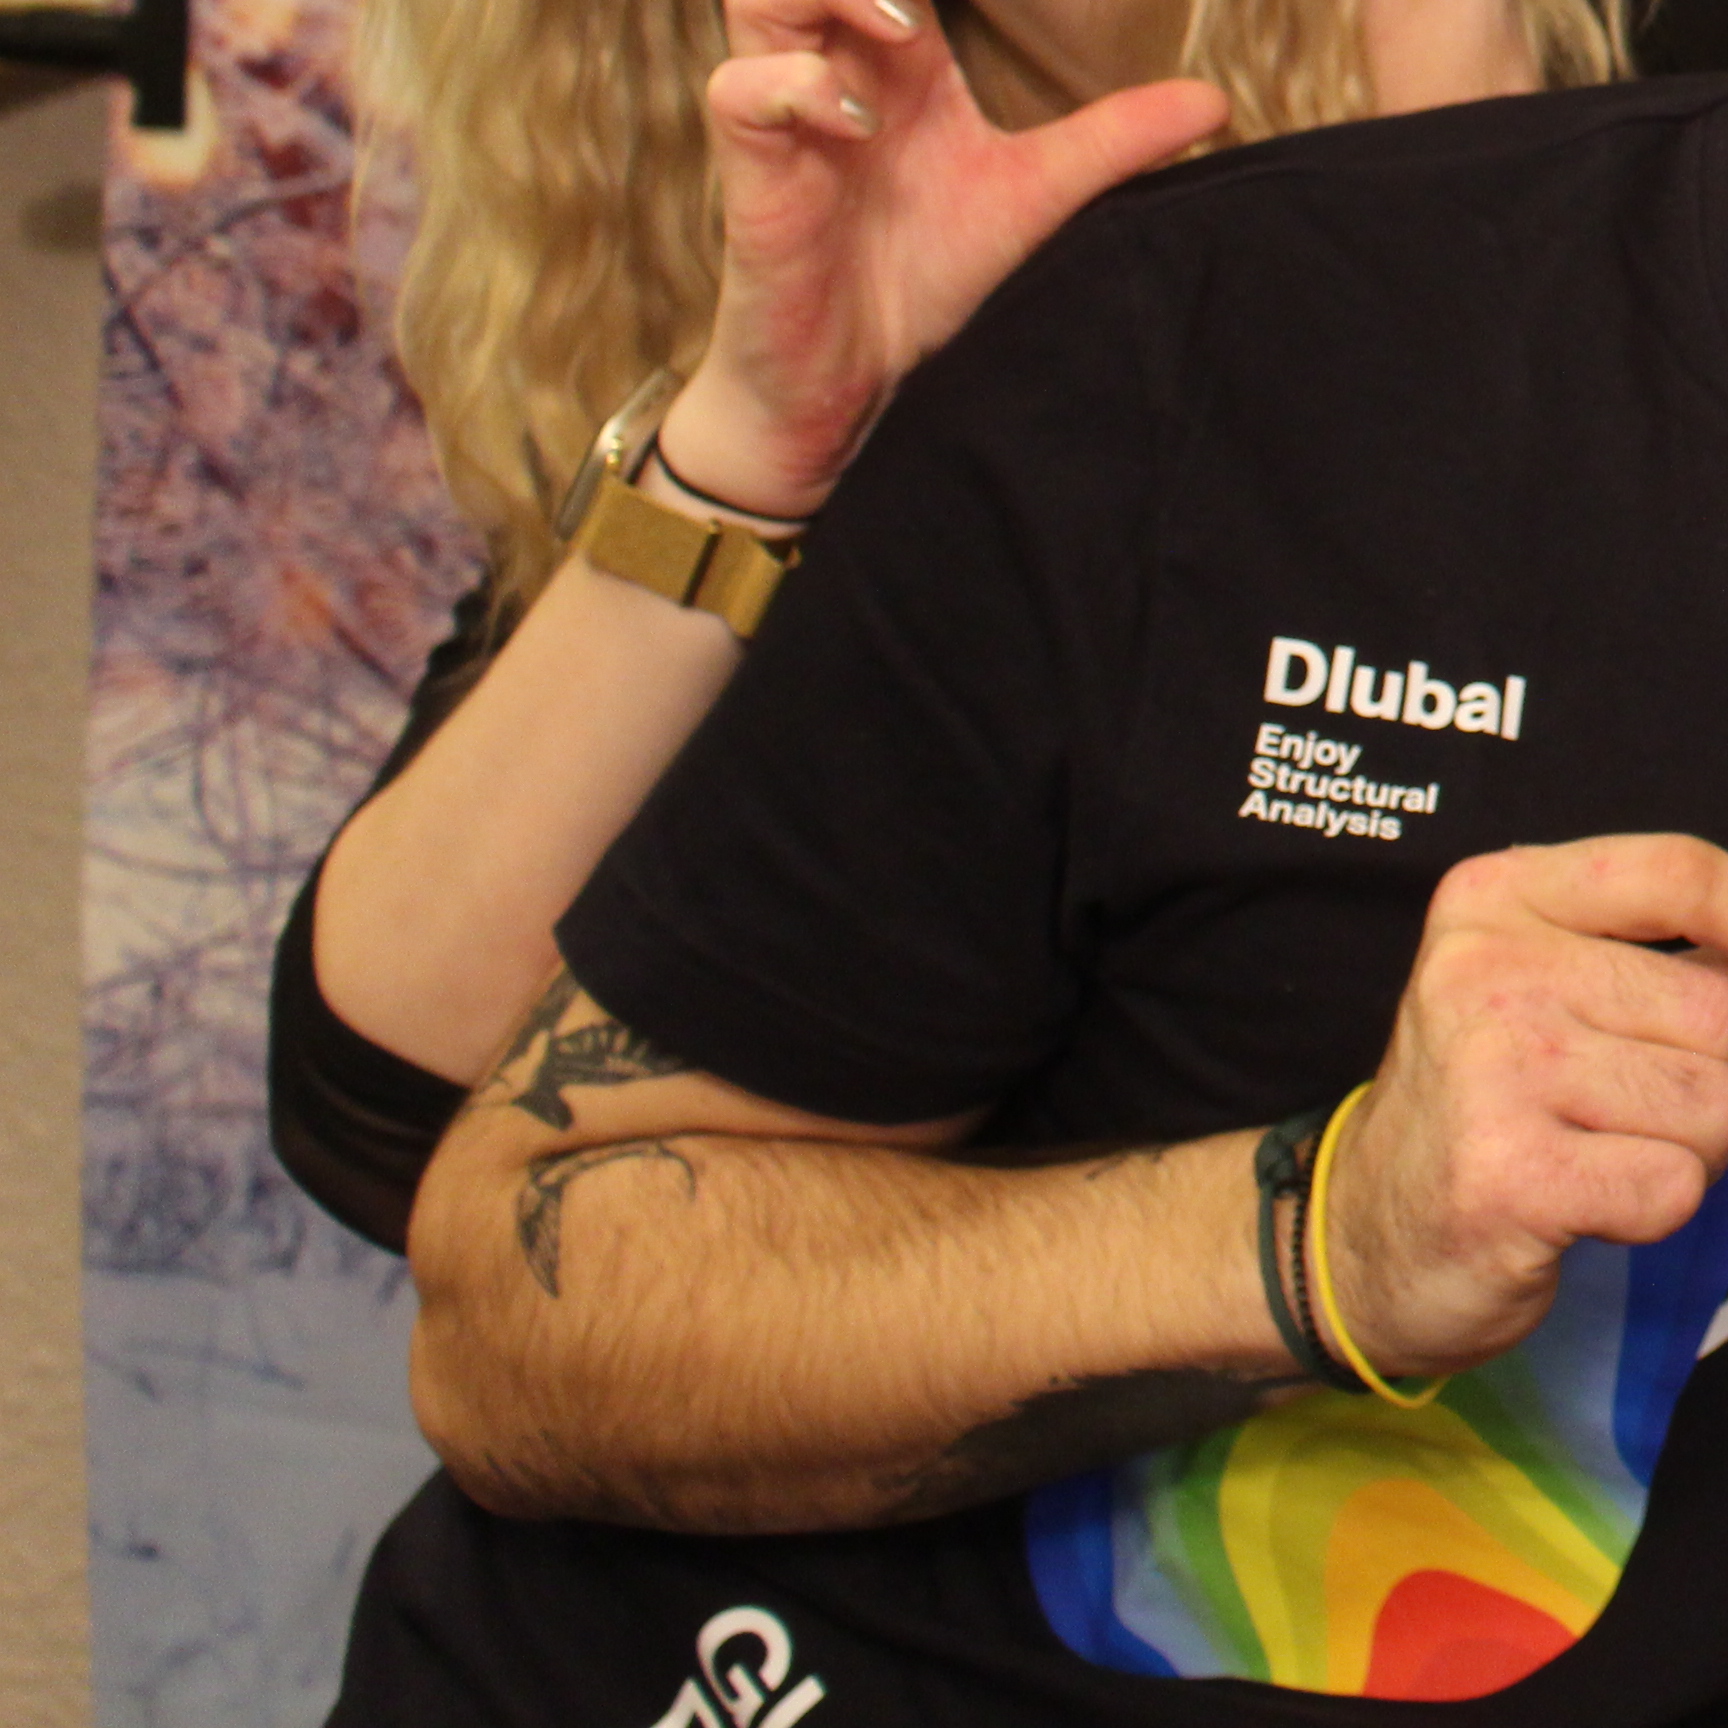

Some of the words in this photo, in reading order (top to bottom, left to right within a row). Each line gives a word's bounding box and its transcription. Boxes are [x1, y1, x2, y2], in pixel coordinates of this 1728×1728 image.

[1263, 636, 1527, 741] Dlubal
[1255, 722, 1362, 775] Enjoy
[1247, 757, 1440, 814] Structural
[1238, 789, 1402, 841] Analysis
